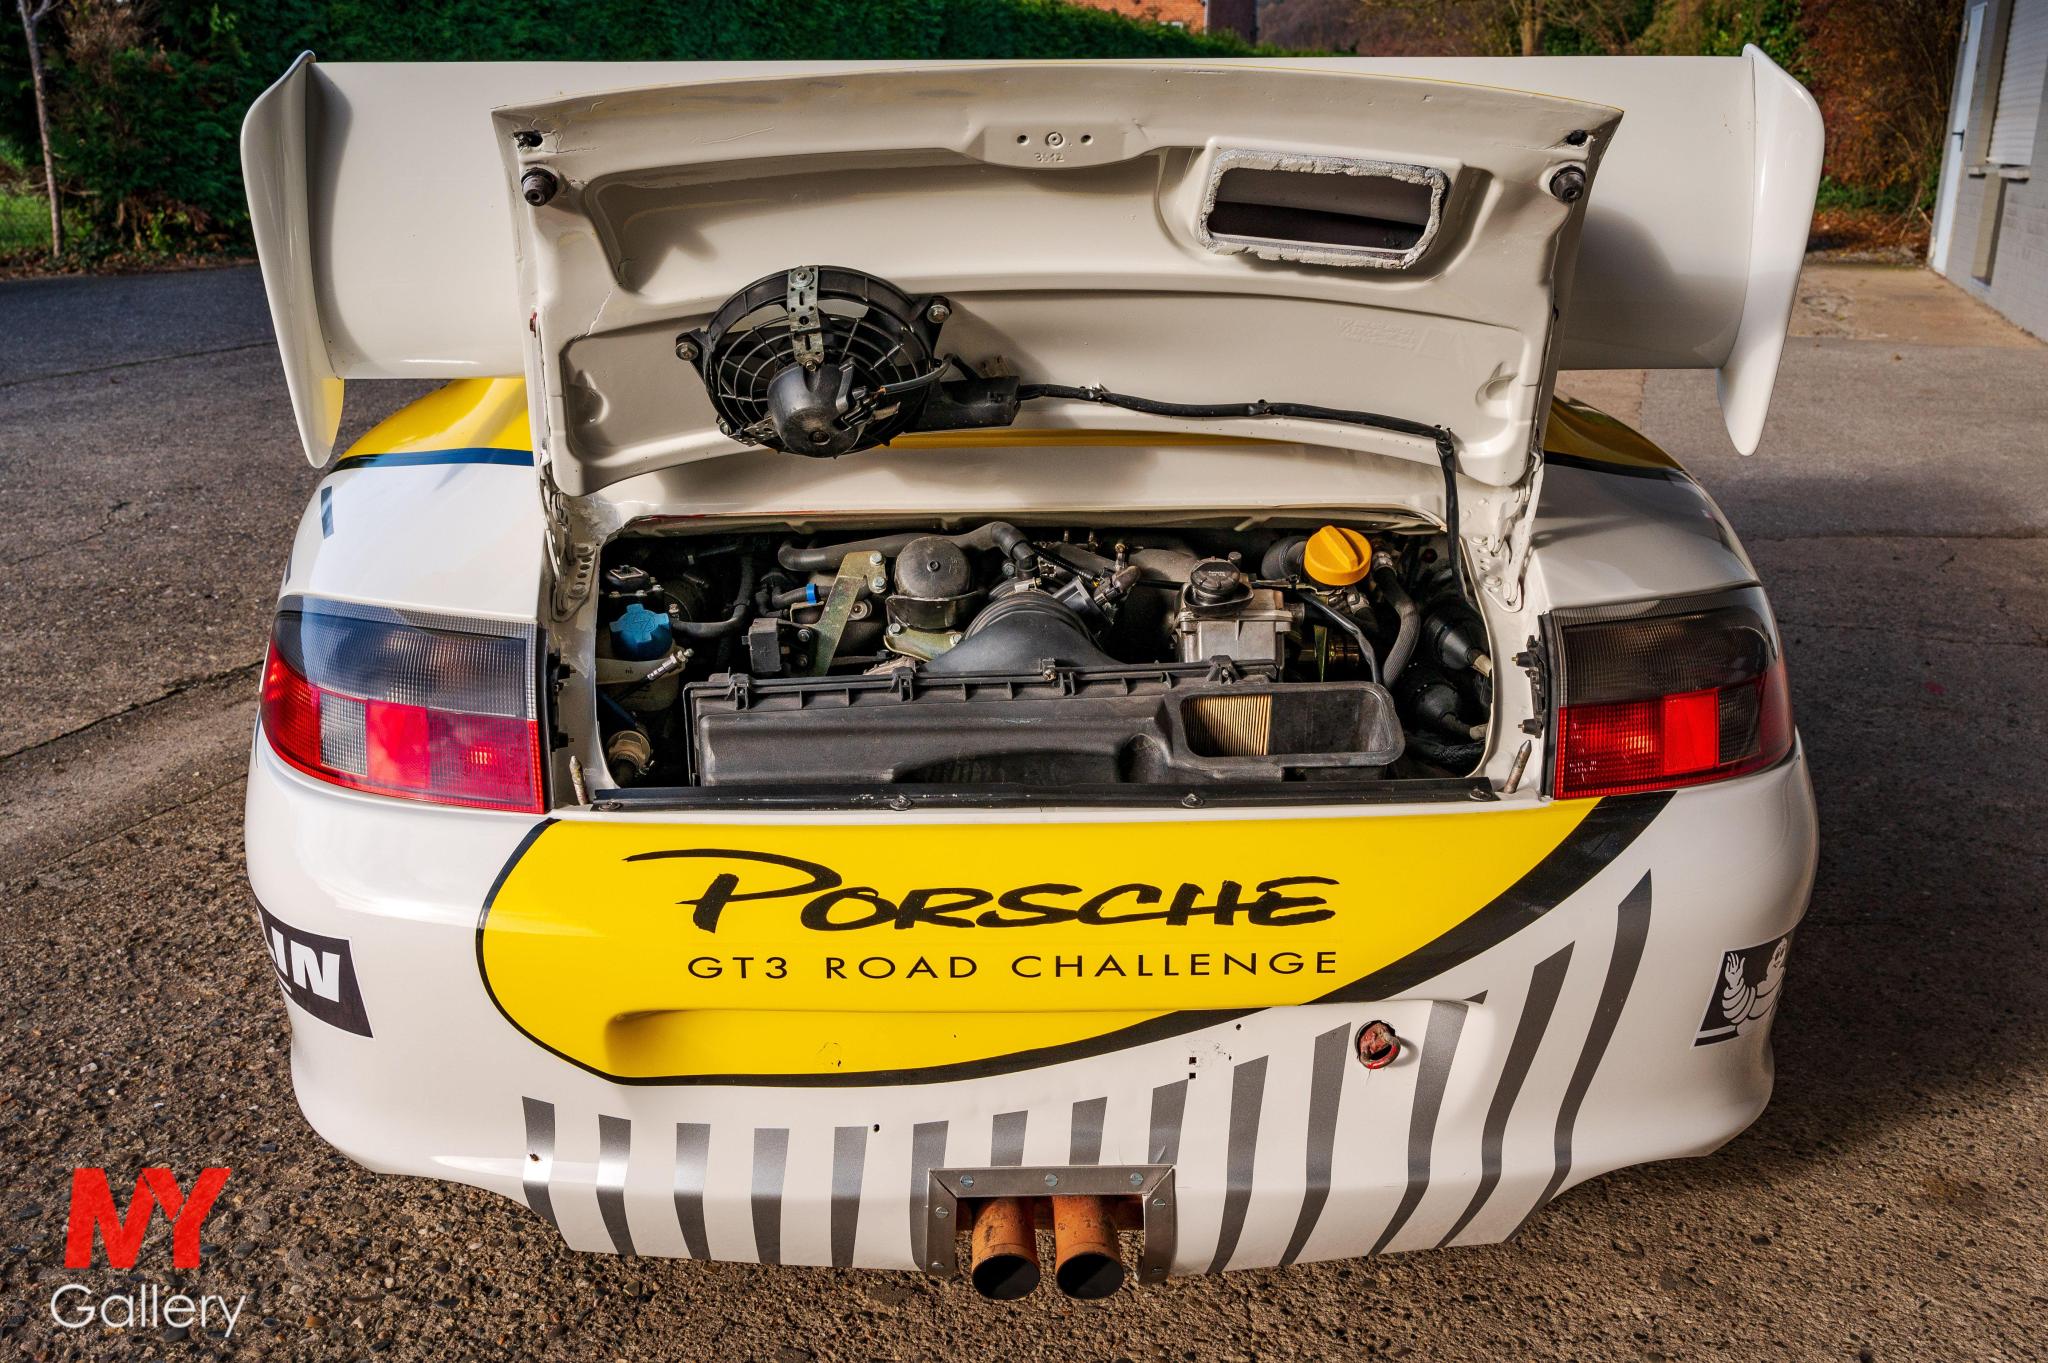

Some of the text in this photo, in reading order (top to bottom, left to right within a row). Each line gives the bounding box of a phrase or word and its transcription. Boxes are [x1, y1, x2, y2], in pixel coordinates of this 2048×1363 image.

[621, 848, 1340, 934] PORSCHE
[687, 951, 1337, 980] GT3 ROAD CHALLENGE
